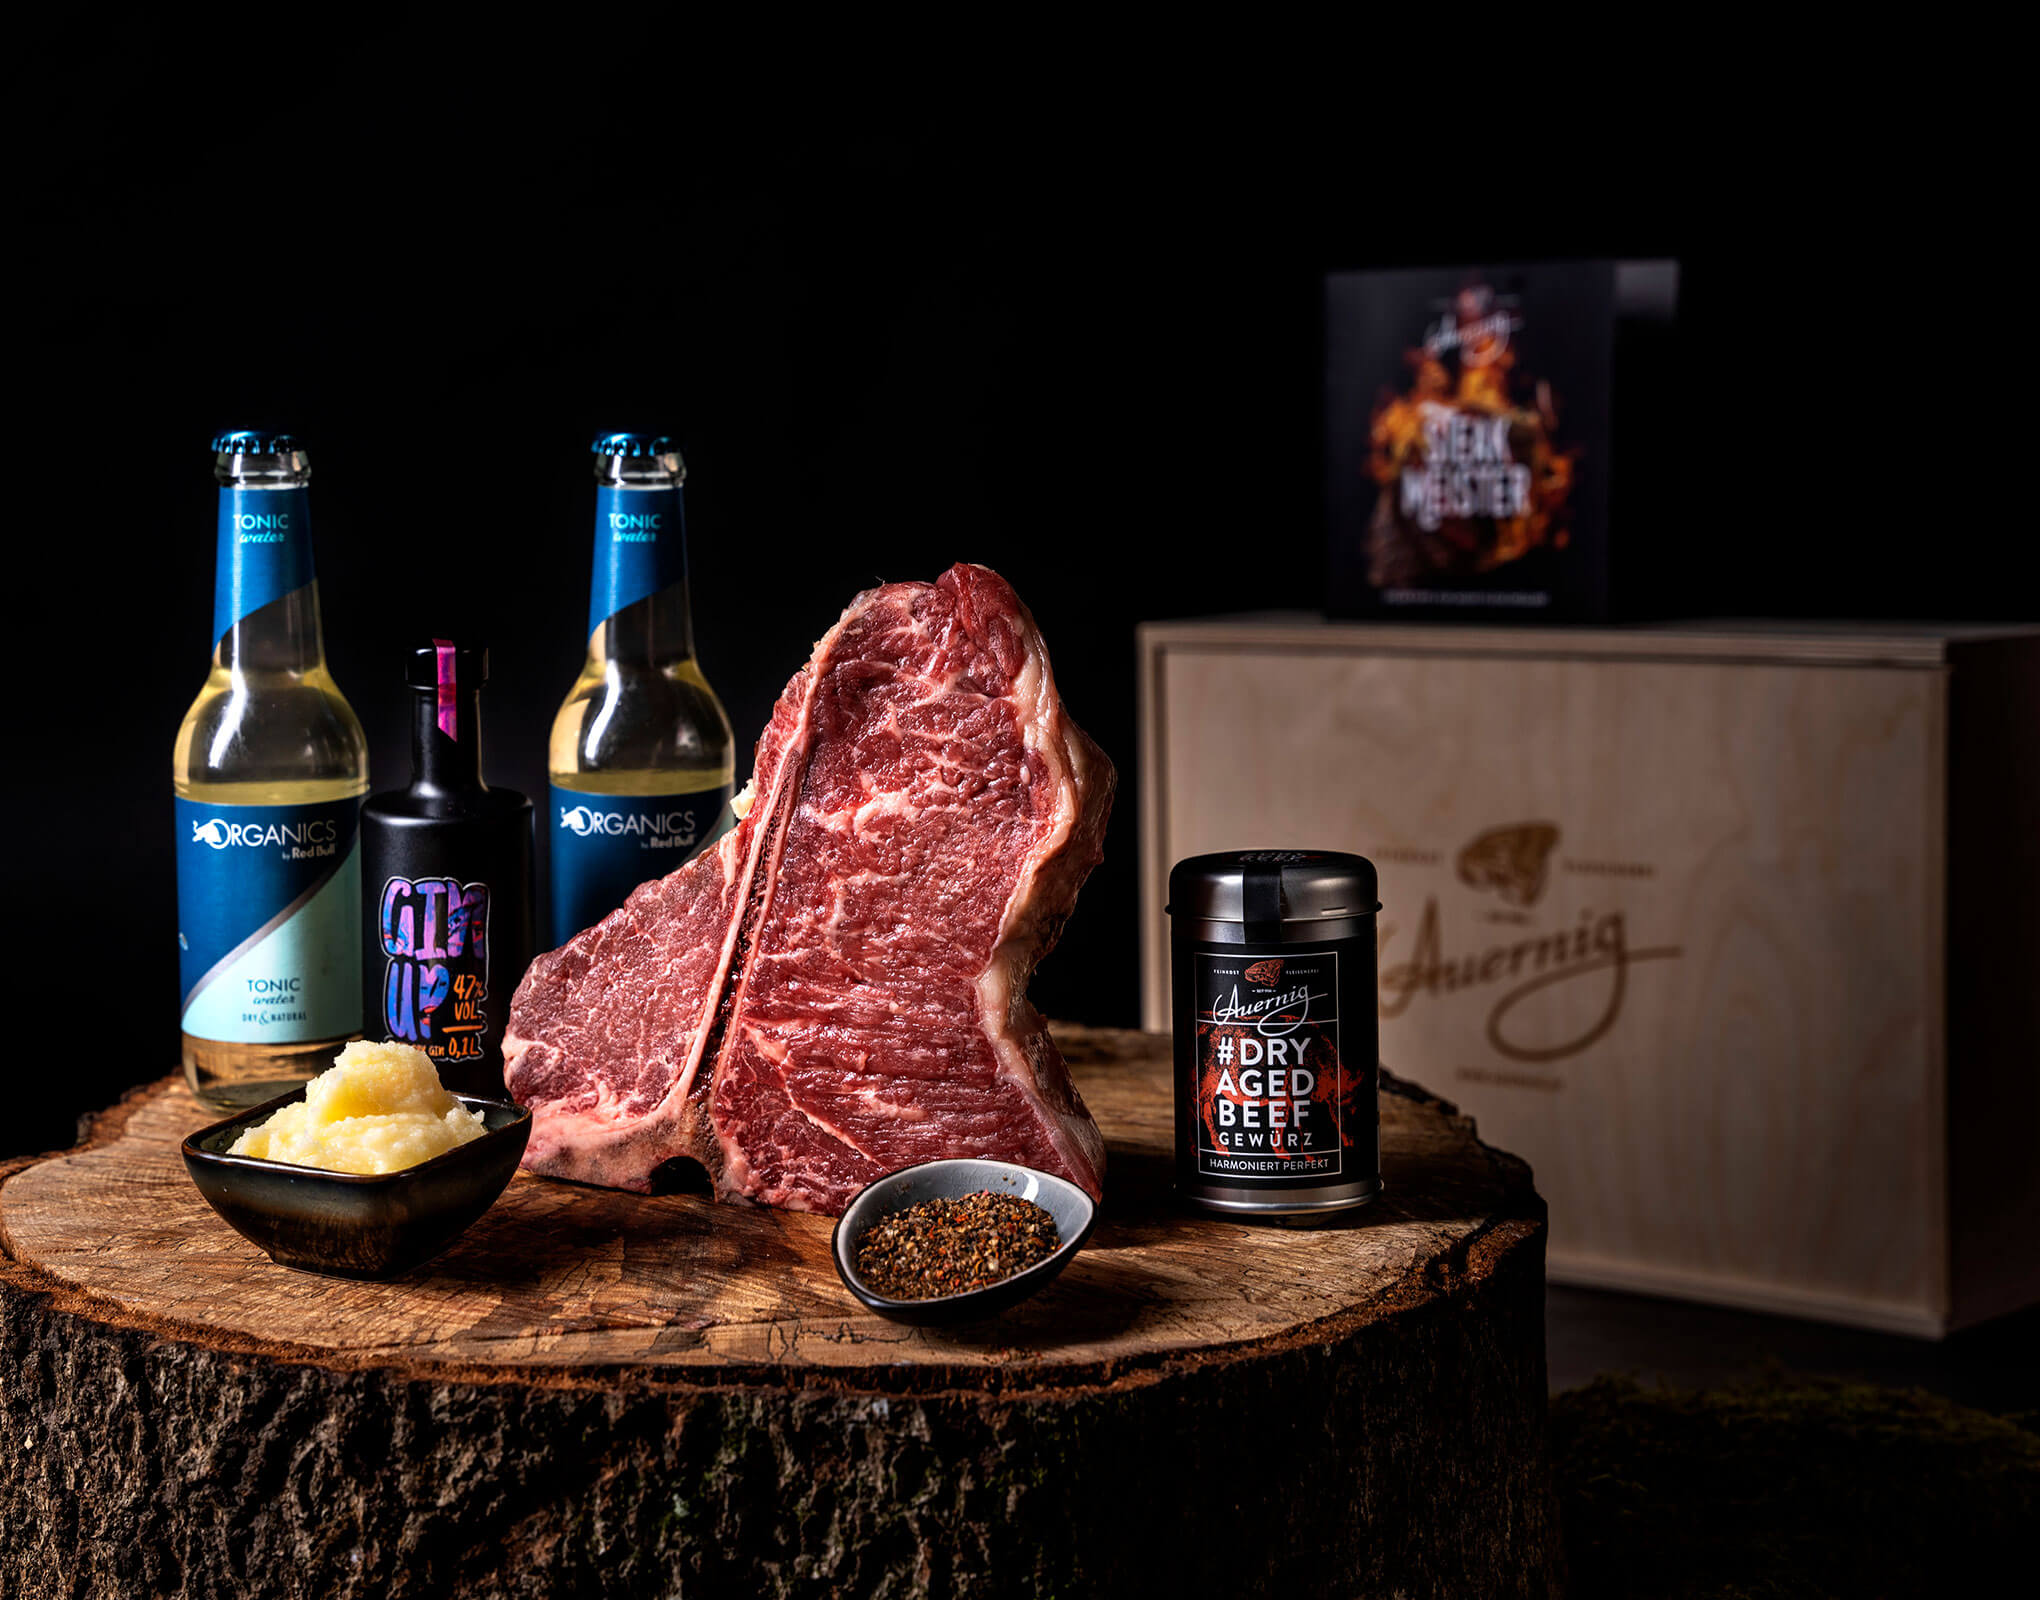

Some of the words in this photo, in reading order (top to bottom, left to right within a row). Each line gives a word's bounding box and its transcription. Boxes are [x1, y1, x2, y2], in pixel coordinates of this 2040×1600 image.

[233, 513, 289, 530] TONIC
[608, 513, 662, 529] TONIC
[238, 531, 285, 544] water
[204, 818, 337, 849] ORGANICS
[571, 806, 696, 836] ORGANICS
[291, 845, 315, 860] Red
[316, 842, 336, 857] Bull
[383, 880, 485, 960] GIN
[247, 978, 301, 993] TONIC
[453, 974, 484, 1000] 47%
[387, 963, 450, 1042] UP
[1213, 984, 1329, 1037] Auernig
[1217, 1036, 1312, 1066] #DRY
[1215, 1068, 1314, 1097] AGED
[1218, 1099, 1311, 1128] BEEF
[1218, 1130, 1313, 1147] GEWÜRZ
[1209, 1158, 1280, 1171] HARMONIERT
[1283, 1158, 1329, 1171] PERFEKT
